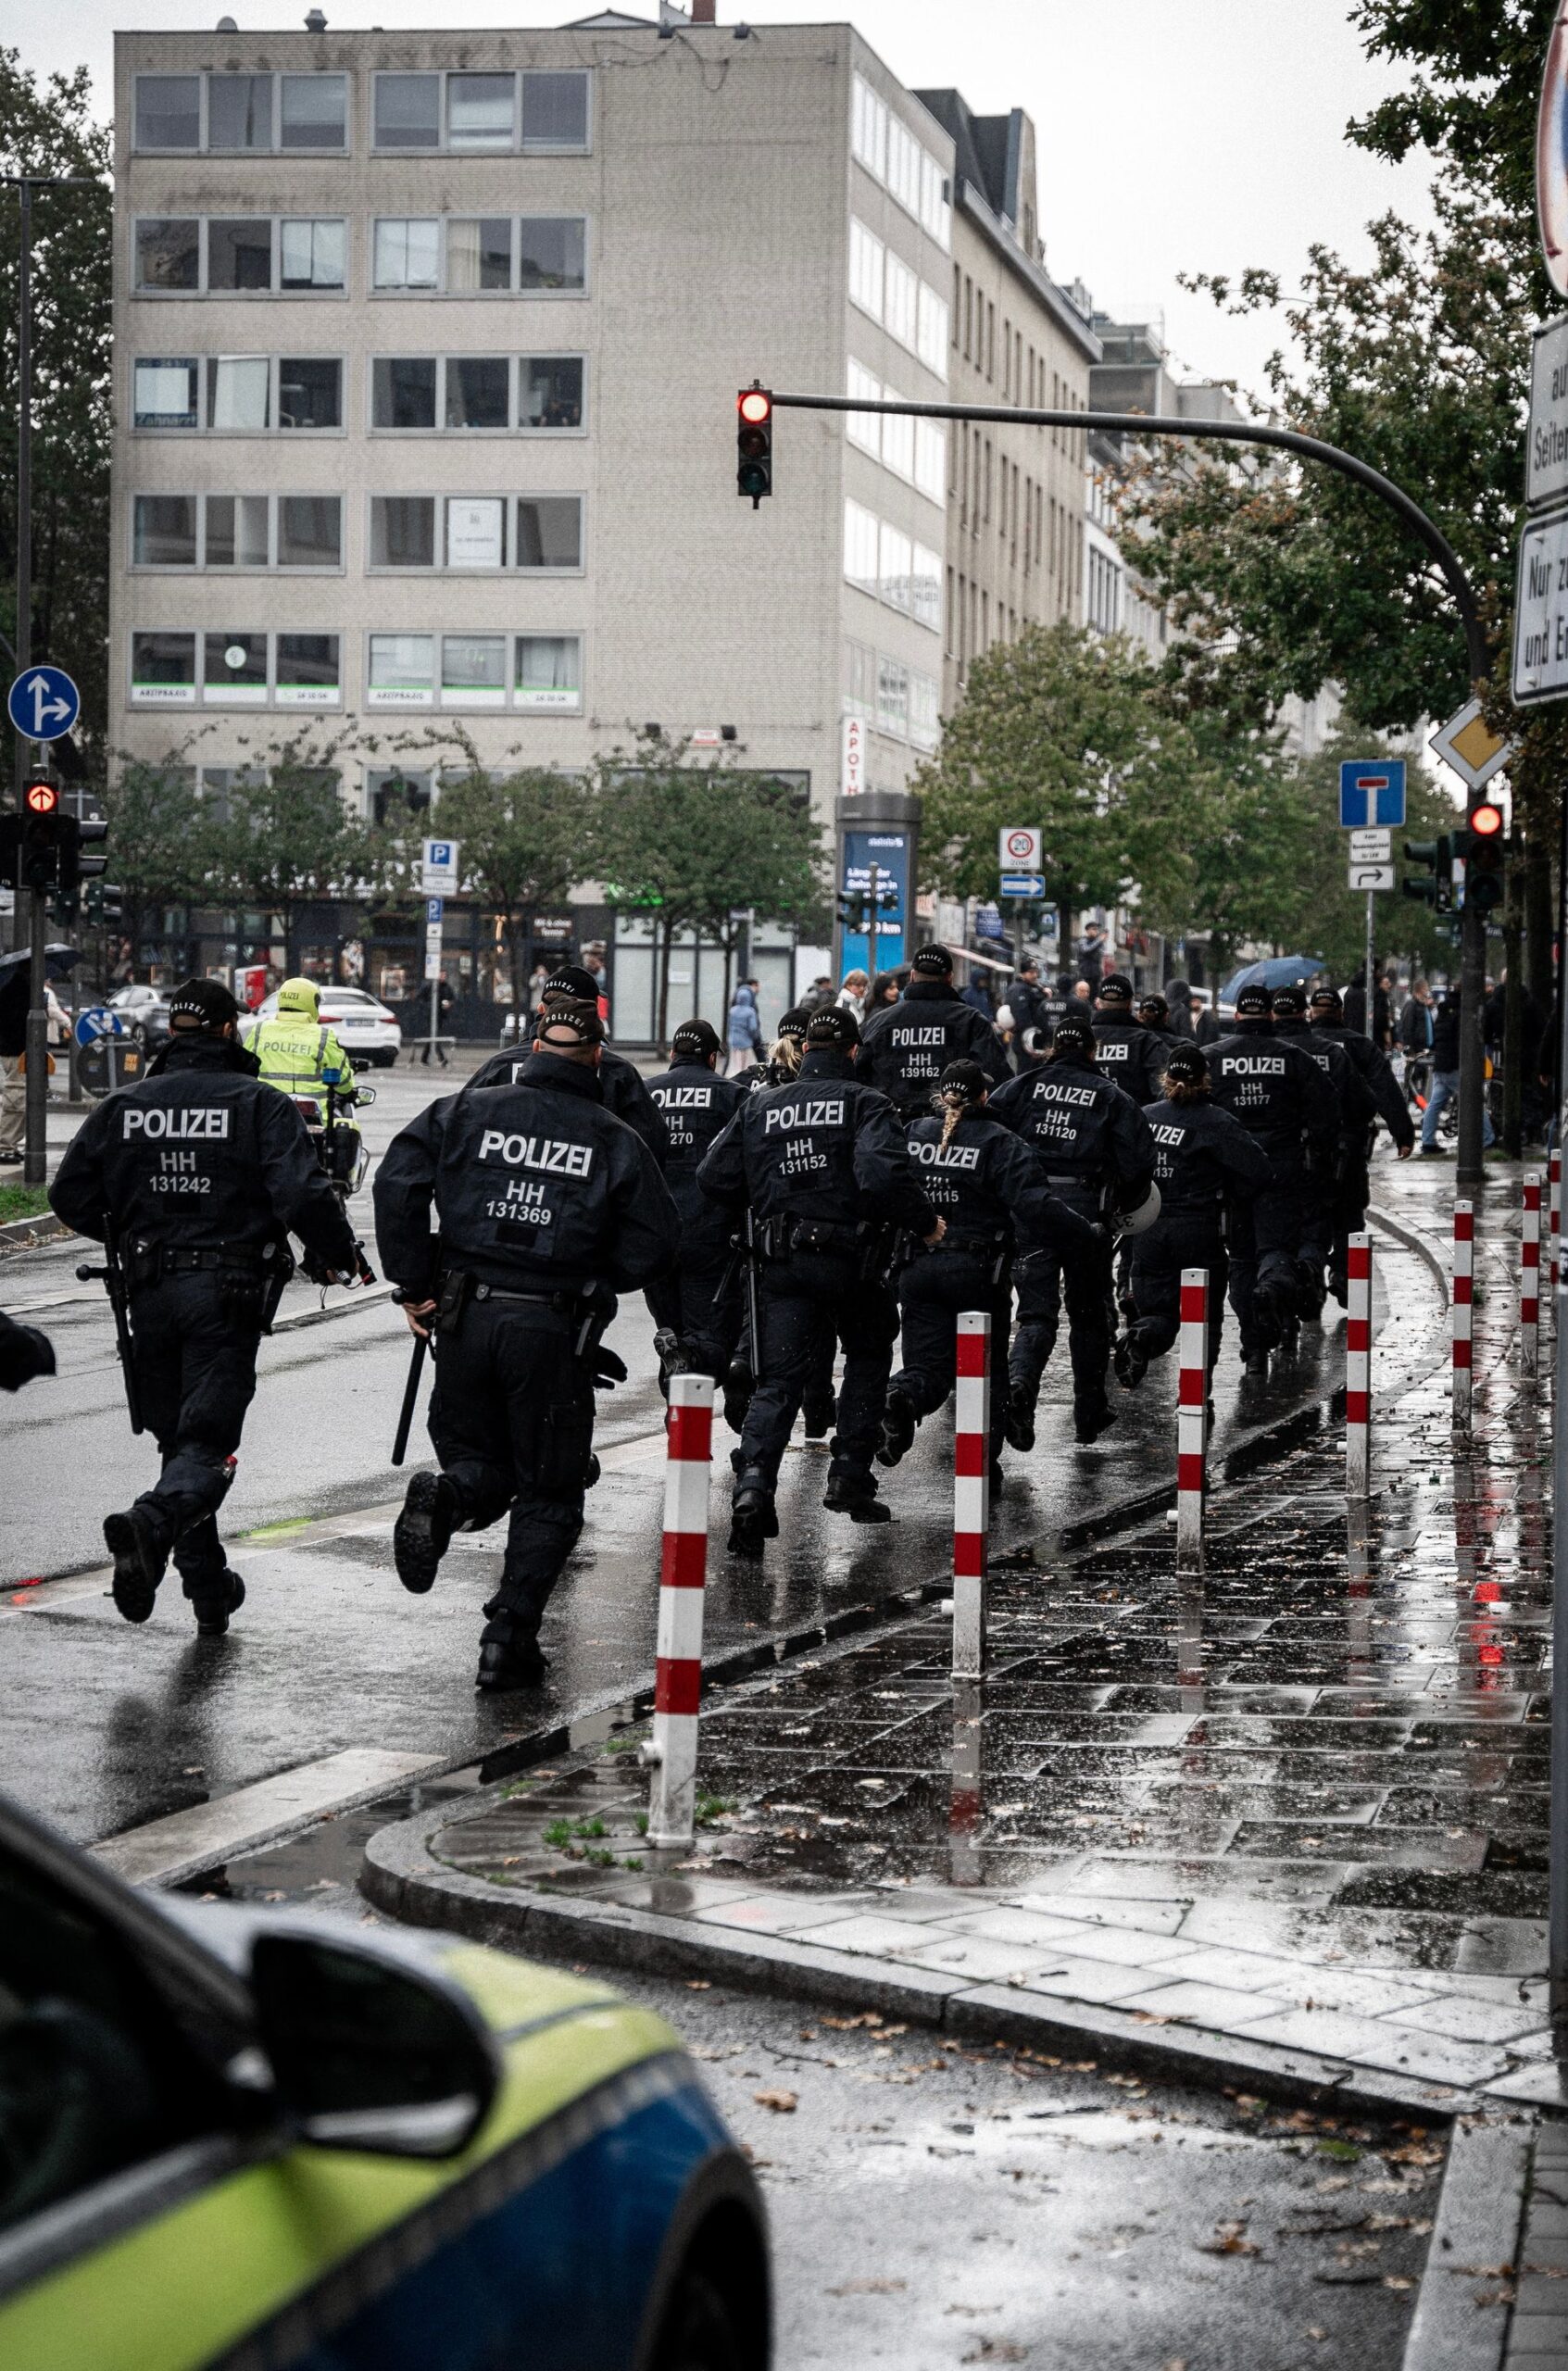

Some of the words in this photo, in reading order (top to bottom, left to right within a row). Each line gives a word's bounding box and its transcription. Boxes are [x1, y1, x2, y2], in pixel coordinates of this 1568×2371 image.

[1552, 364, 1568, 401] au
[1528, 554, 1552, 600] Nur
[1525, 619, 1549, 668] und
[918, 953, 945, 964] POLIZEI
[546, 980, 575, 994] POLIZEI
[170, 1002, 206, 1015] POLIZEI
[546, 1012, 585, 1028] POLIZEI
[809, 1015, 840, 1028] POLIZEI
[675, 1031, 702, 1044] POLIZEI
[779, 1023, 805, 1035] POLIZEI
[892, 1026, 945, 1047] POLIZEI
[263, 1041, 311, 1055] POLIZEI
[1094, 1044, 1128, 1061] LIZEI
[909, 1052, 932, 1066] HH
[1222, 1057, 1285, 1075] POLIZEI
[899, 1067, 940, 1078] 139162
[1033, 1082, 1097, 1107] POLIZEI
[1240, 1082, 1263, 1095] HH
[650, 1087, 711, 1108] OLIZEI
[1233, 1095, 1271, 1107] 131177
[123, 1109, 229, 1139] POLIZEI
[765, 1101, 845, 1134] POLIZEI
[1045, 1109, 1071, 1126] HH
[670, 1133, 694, 1145] 270
[1035, 1123, 1077, 1140] 131120
[478, 1130, 593, 1177] POLIZEI
[786, 1137, 813, 1159] HH
[907, 1141, 981, 1171] POLIZEI
[160, 1151, 196, 1172] HH
[779, 1154, 828, 1175] 131152
[1153, 1167, 1174, 1178] 137
[149, 1175, 211, 1193] 131242
[506, 1179, 546, 1205] HH
[923, 1190, 960, 1203] 1115
[486, 1200, 552, 1225] 131369
